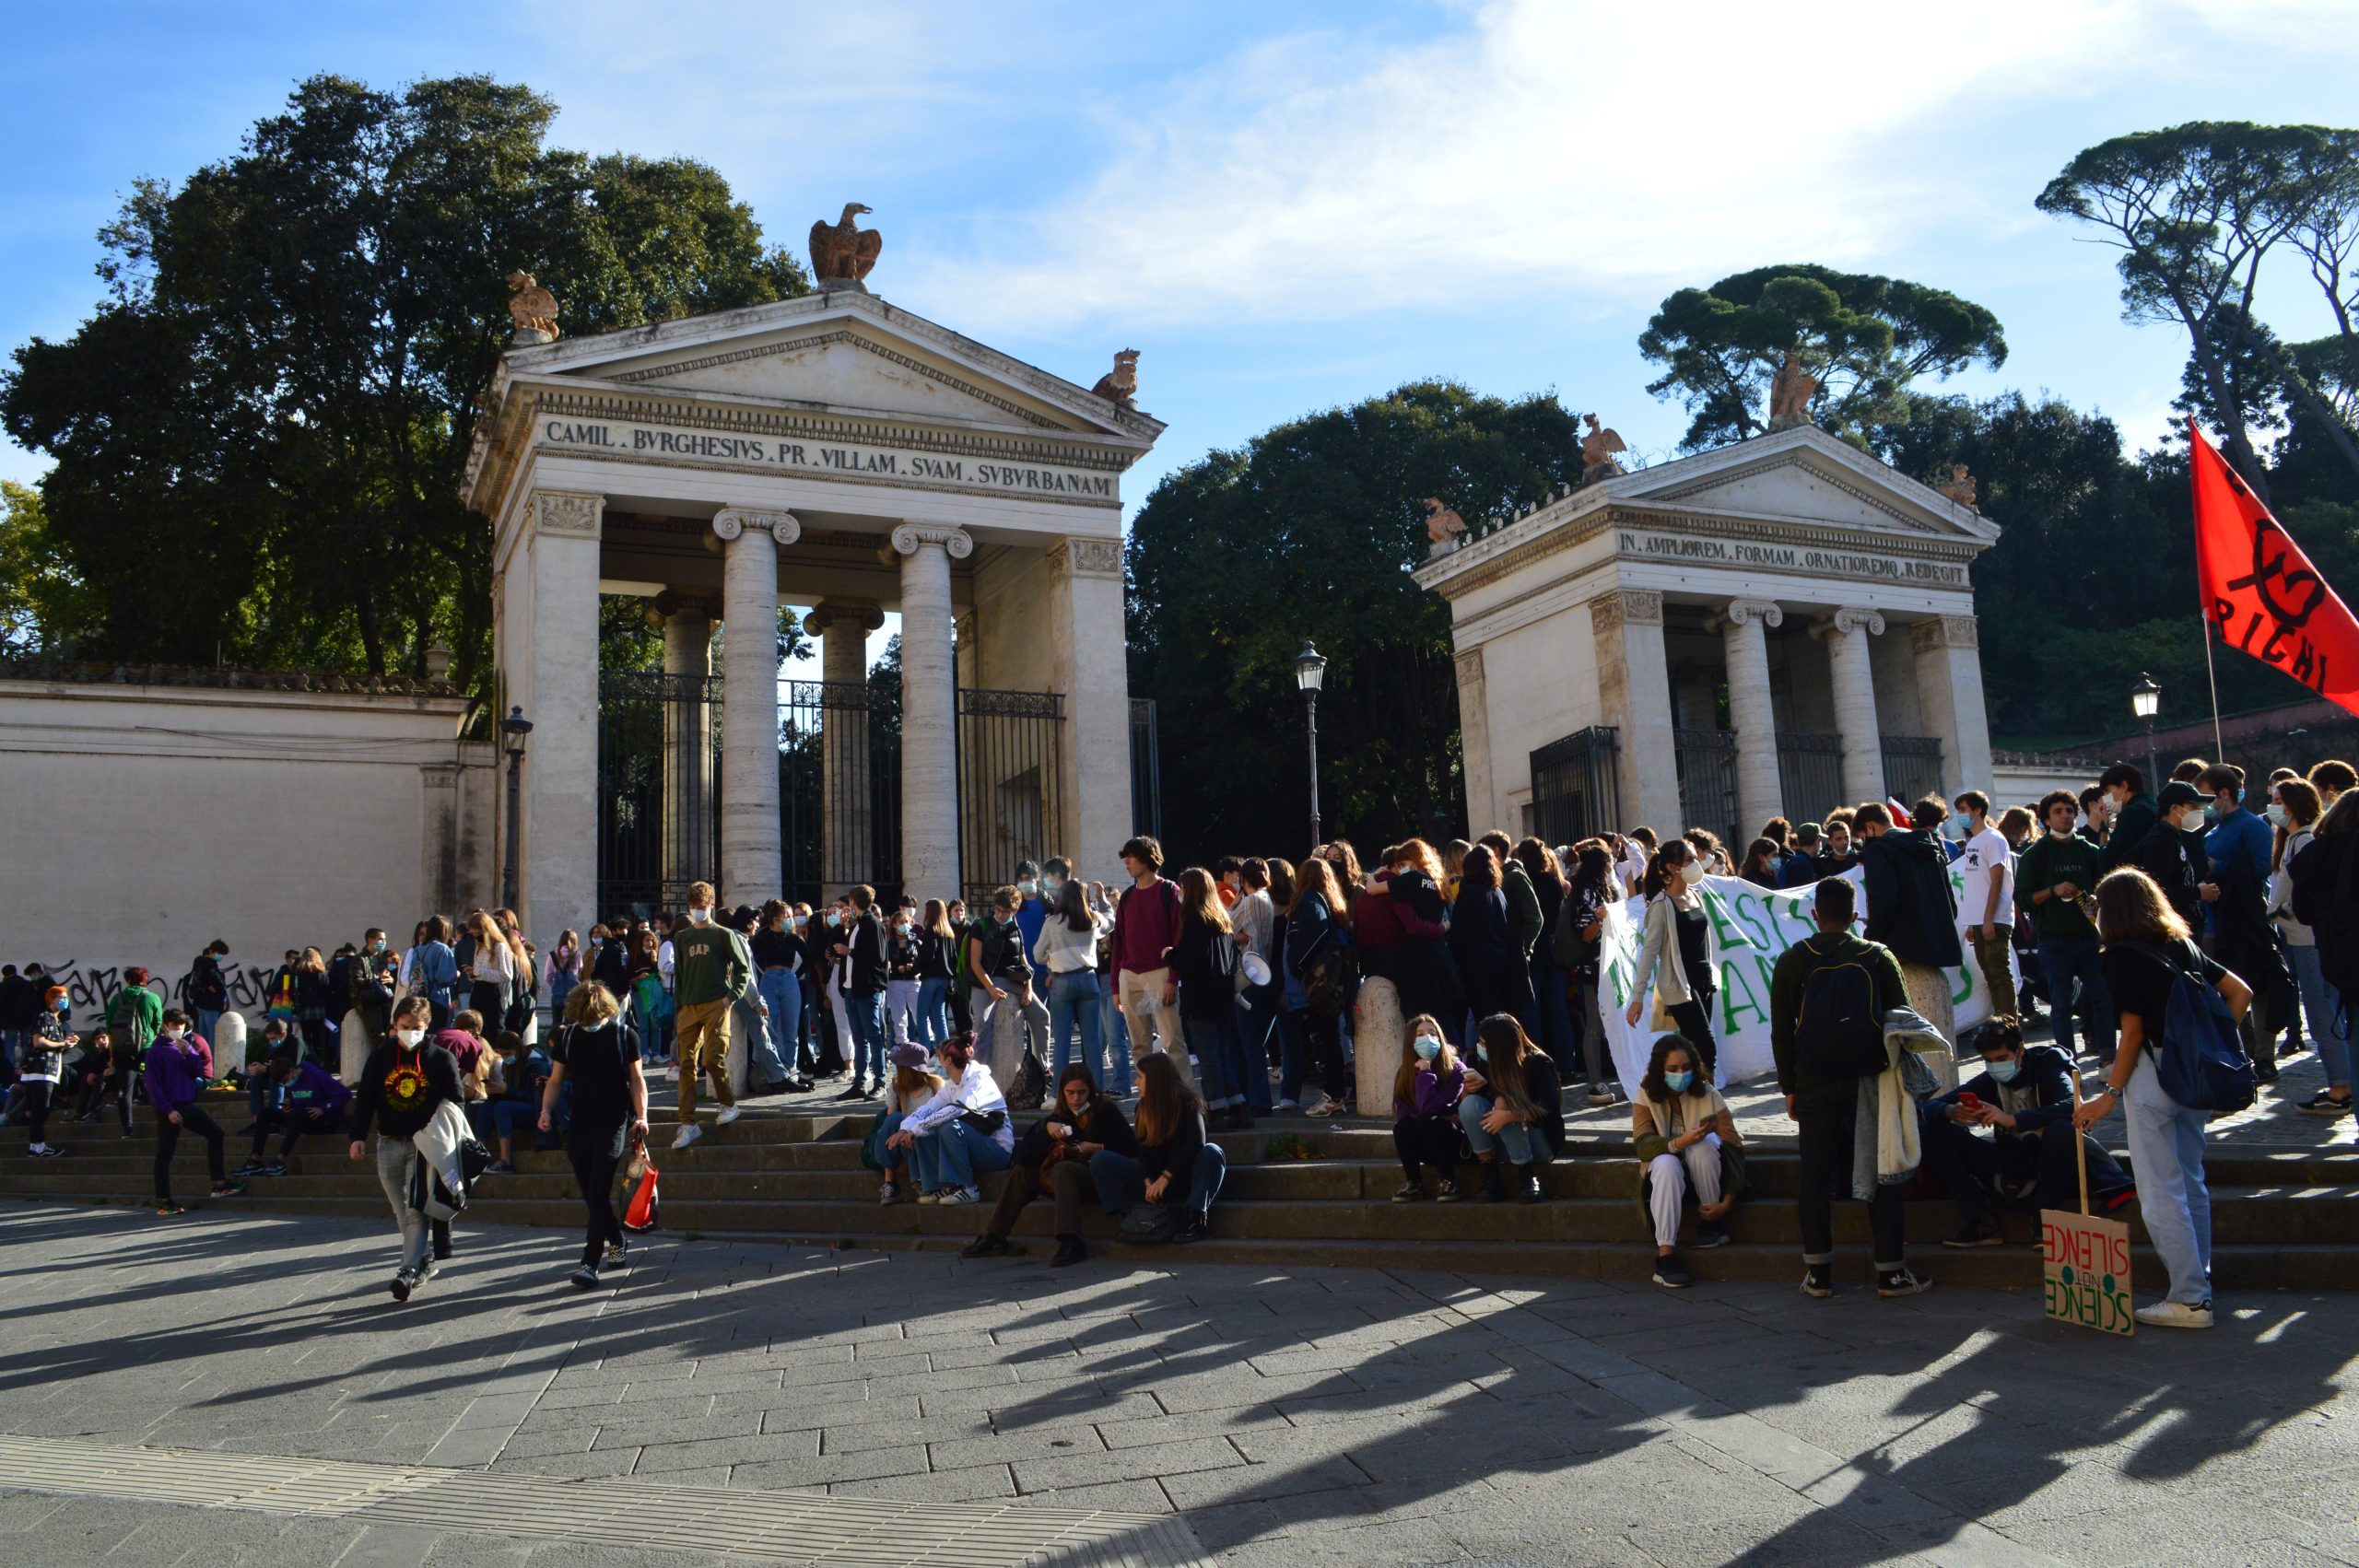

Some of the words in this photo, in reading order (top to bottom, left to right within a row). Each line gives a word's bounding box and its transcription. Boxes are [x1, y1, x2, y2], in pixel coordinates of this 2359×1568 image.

[688, 943, 710, 957] GAP
[2043, 1223, 2129, 1276] SILENCE
[2076, 1271, 2101, 1289] NOT
[2046, 1280, 2131, 1333] SCIENCE
